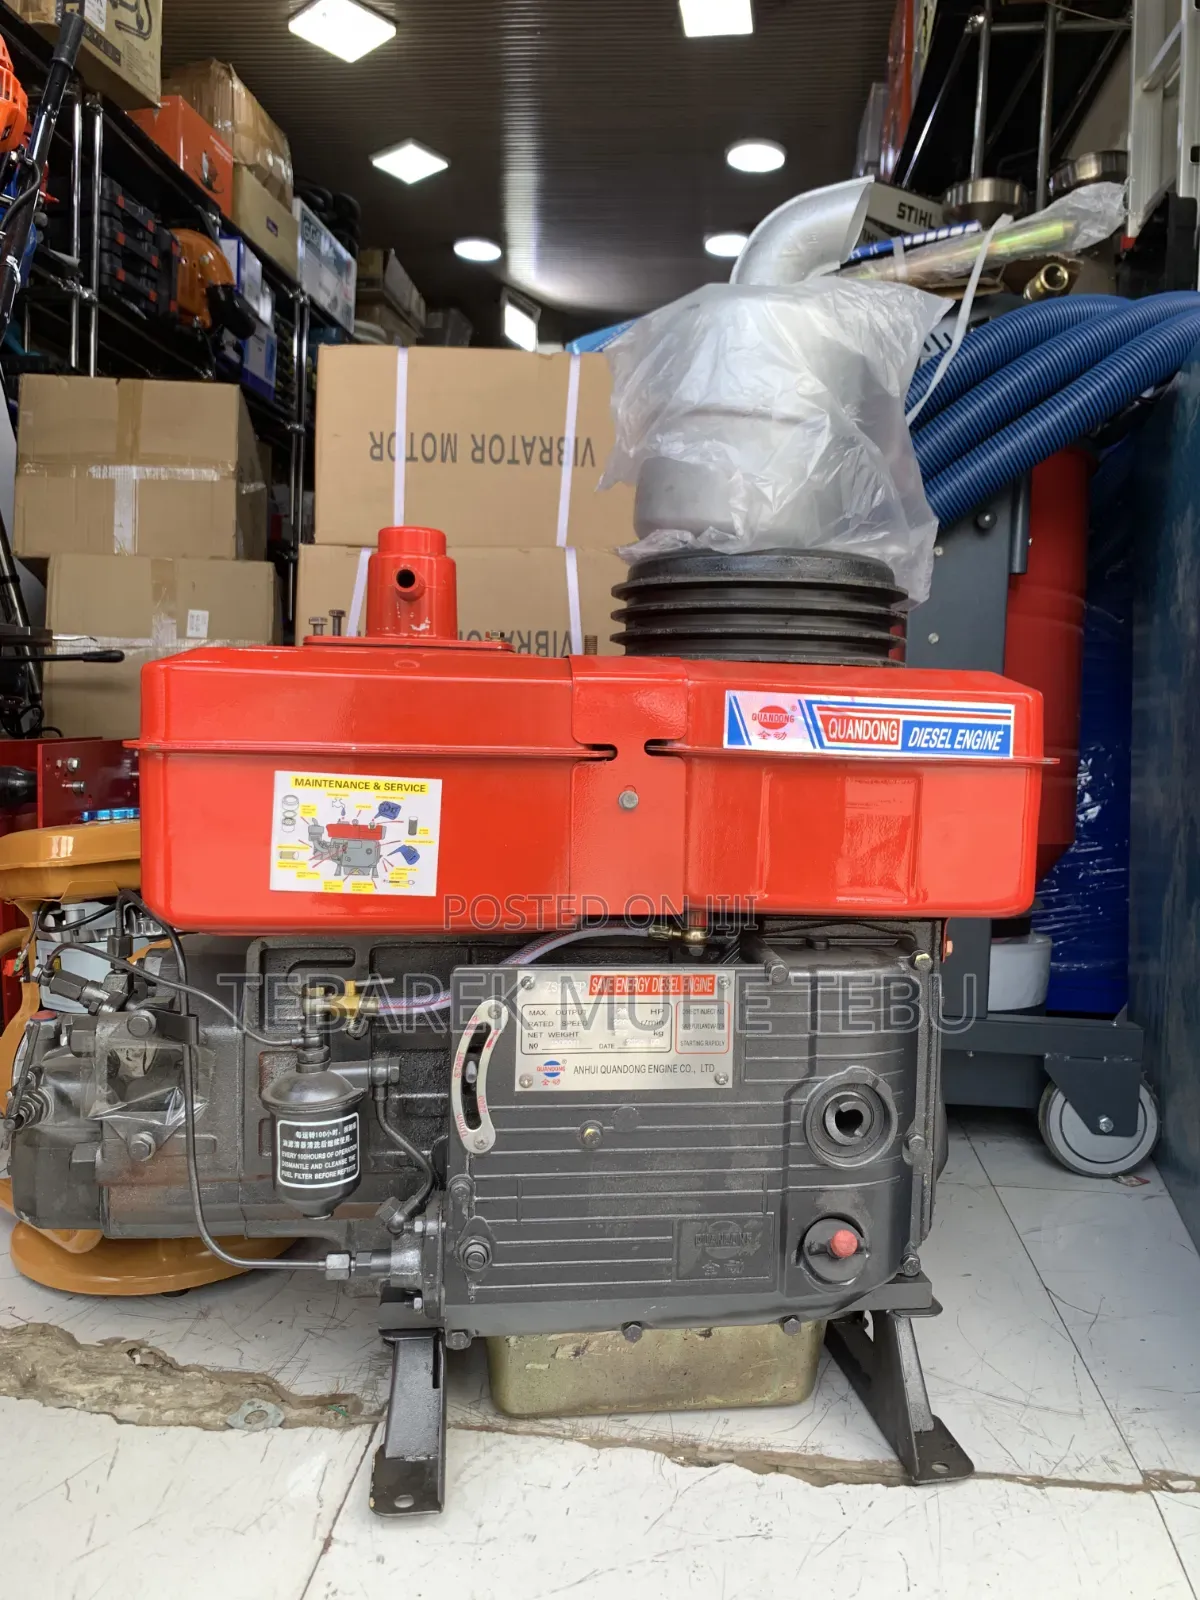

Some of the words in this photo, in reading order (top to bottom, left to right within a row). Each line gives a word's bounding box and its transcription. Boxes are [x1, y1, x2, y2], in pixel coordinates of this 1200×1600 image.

[896, 202, 935, 230] STIHL
[368, 431, 458, 463] MOTOR
[471, 433, 595, 468] VIBRATOR
[752, 712, 795, 723] QUANDONG
[758, 730, 788, 740] 全动
[828, 717, 898, 742] QUANDONG
[908, 727, 952, 748] DIESEL
[954, 729, 1004, 750] ENGINE
[294, 778, 370, 790] MAINTENANCE
[373, 782, 381, 790] &
[384, 783, 426, 792] SERVICE
[591, 977, 614, 992] SAVE
[616, 977, 650, 992] ENERGY
[652, 977, 680, 992] DIESEL
[683, 977, 714, 992] ENGINE
[654, 1030, 664, 1038] kg
[574, 1064, 598, 1075] ANHUI
[600, 1064, 646, 1074] QUANDONG
[648, 1064, 678, 1074] ENGINE
[700, 1063, 715, 1073] LTD
[282, 1150, 298, 1159] EVERY
[282, 1160, 310, 1170] DISMANTLE
[282, 1170, 294, 1178] FUEL
[294, 1172, 313, 1180] FILTER
[314, 1170, 337, 1180] BEFORE
